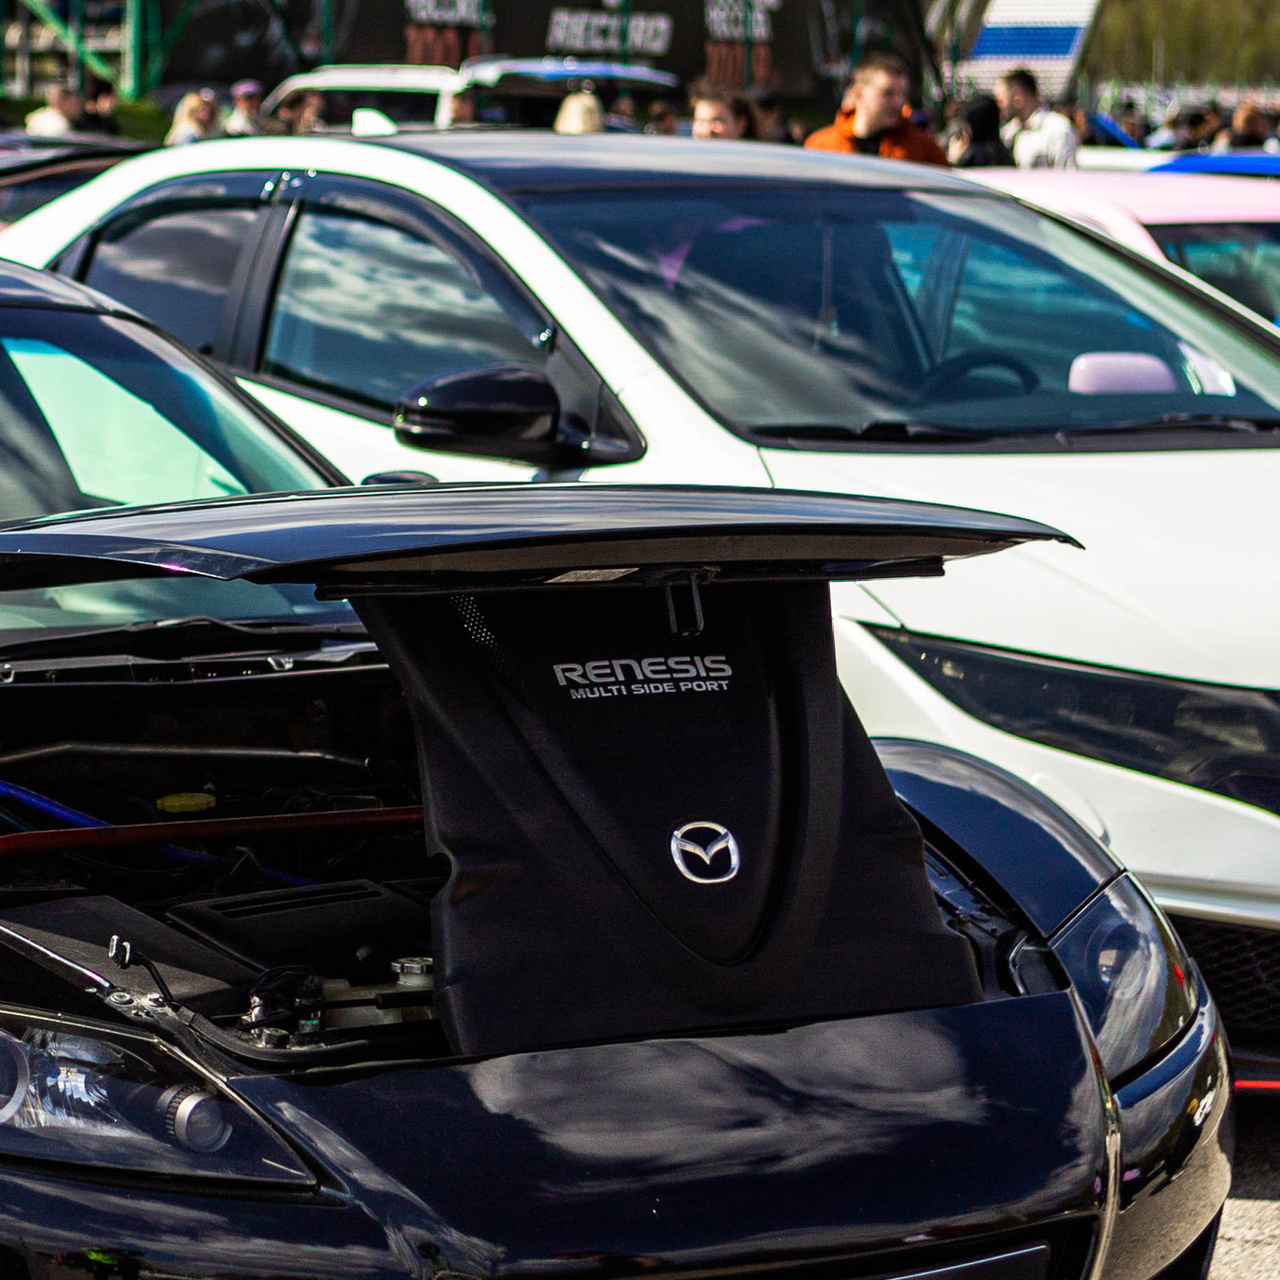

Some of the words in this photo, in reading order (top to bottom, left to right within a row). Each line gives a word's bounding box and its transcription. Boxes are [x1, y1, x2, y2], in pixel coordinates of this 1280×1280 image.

[553, 656, 732, 686] RENESIS
[570, 685, 627, 700] MULTI
[631, 682, 676, 695] SIDE
[679, 680, 729, 692] PORT
